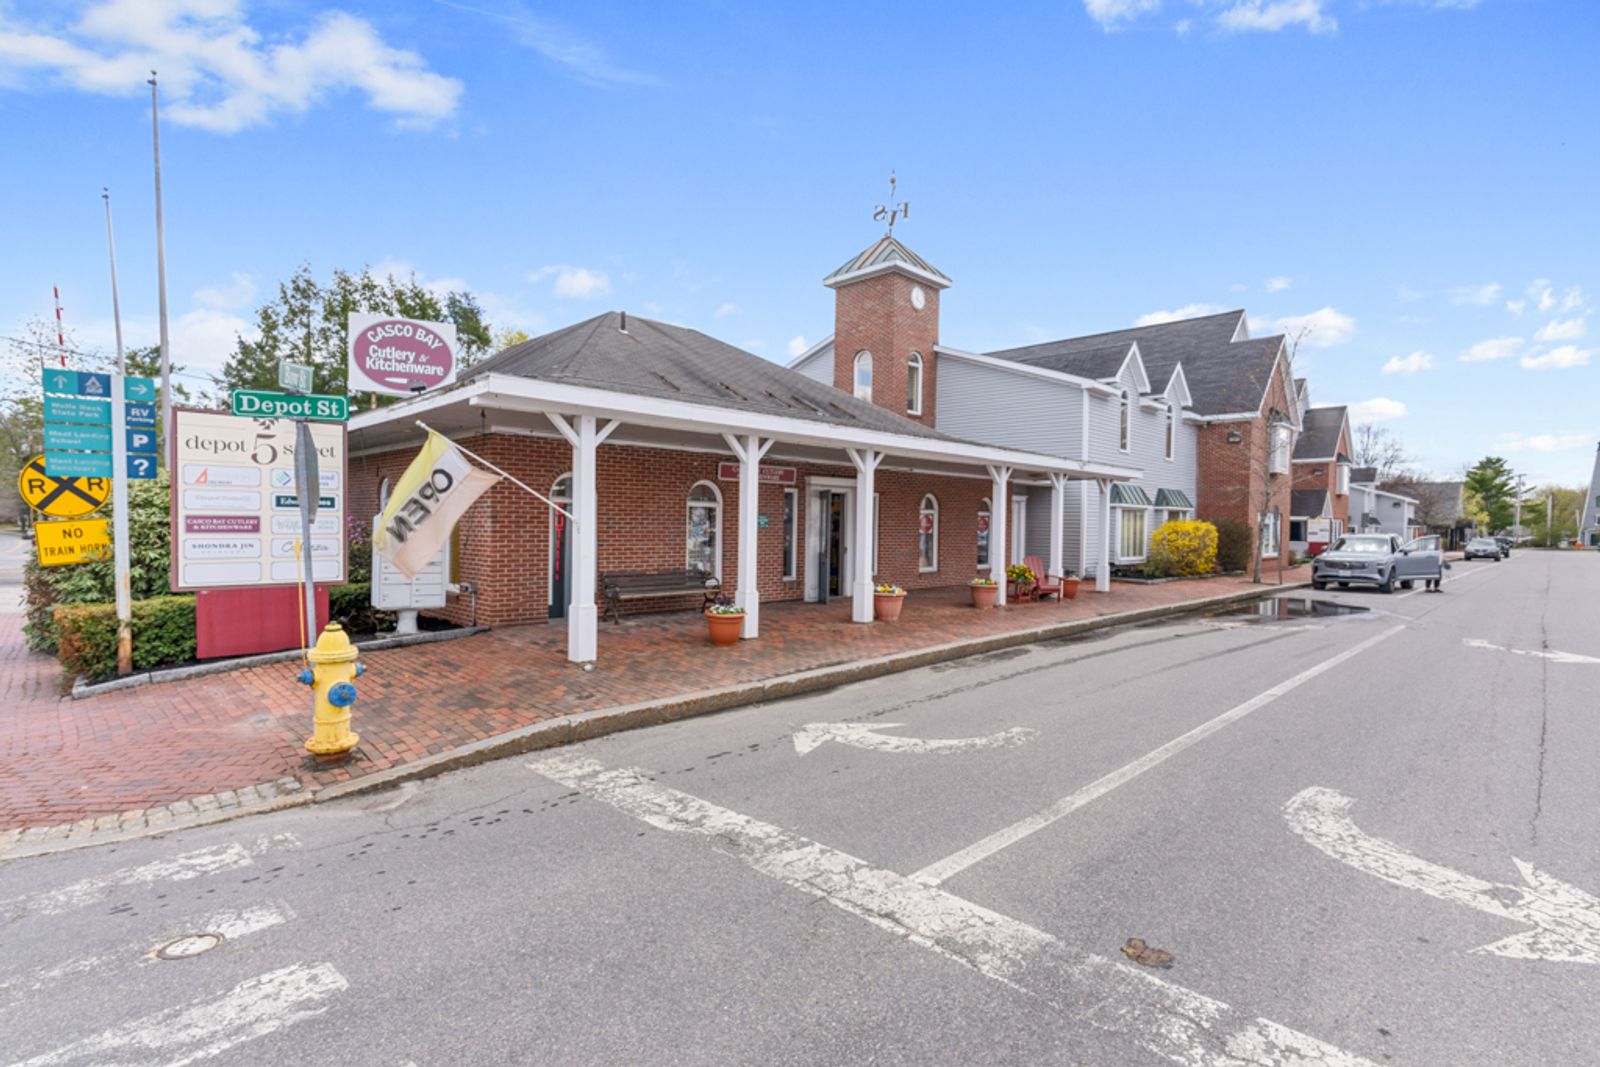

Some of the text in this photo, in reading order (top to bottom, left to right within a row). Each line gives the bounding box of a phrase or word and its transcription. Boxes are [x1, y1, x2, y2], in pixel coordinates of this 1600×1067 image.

[367, 324, 443, 350] CASCO BAY
[368, 345, 429, 364] Cutlery &
[366, 356, 444, 376] Kitchenware
[131, 408, 149, 417] RV
[239, 394, 340, 416] Depot St
[133, 433, 149, 448] P
[185, 435, 247, 454] depot
[251, 434, 278, 465] 5
[28, 477, 104, 494] R R
[62, 528, 83, 539] NO
[44, 545, 75, 557] TRAIN
